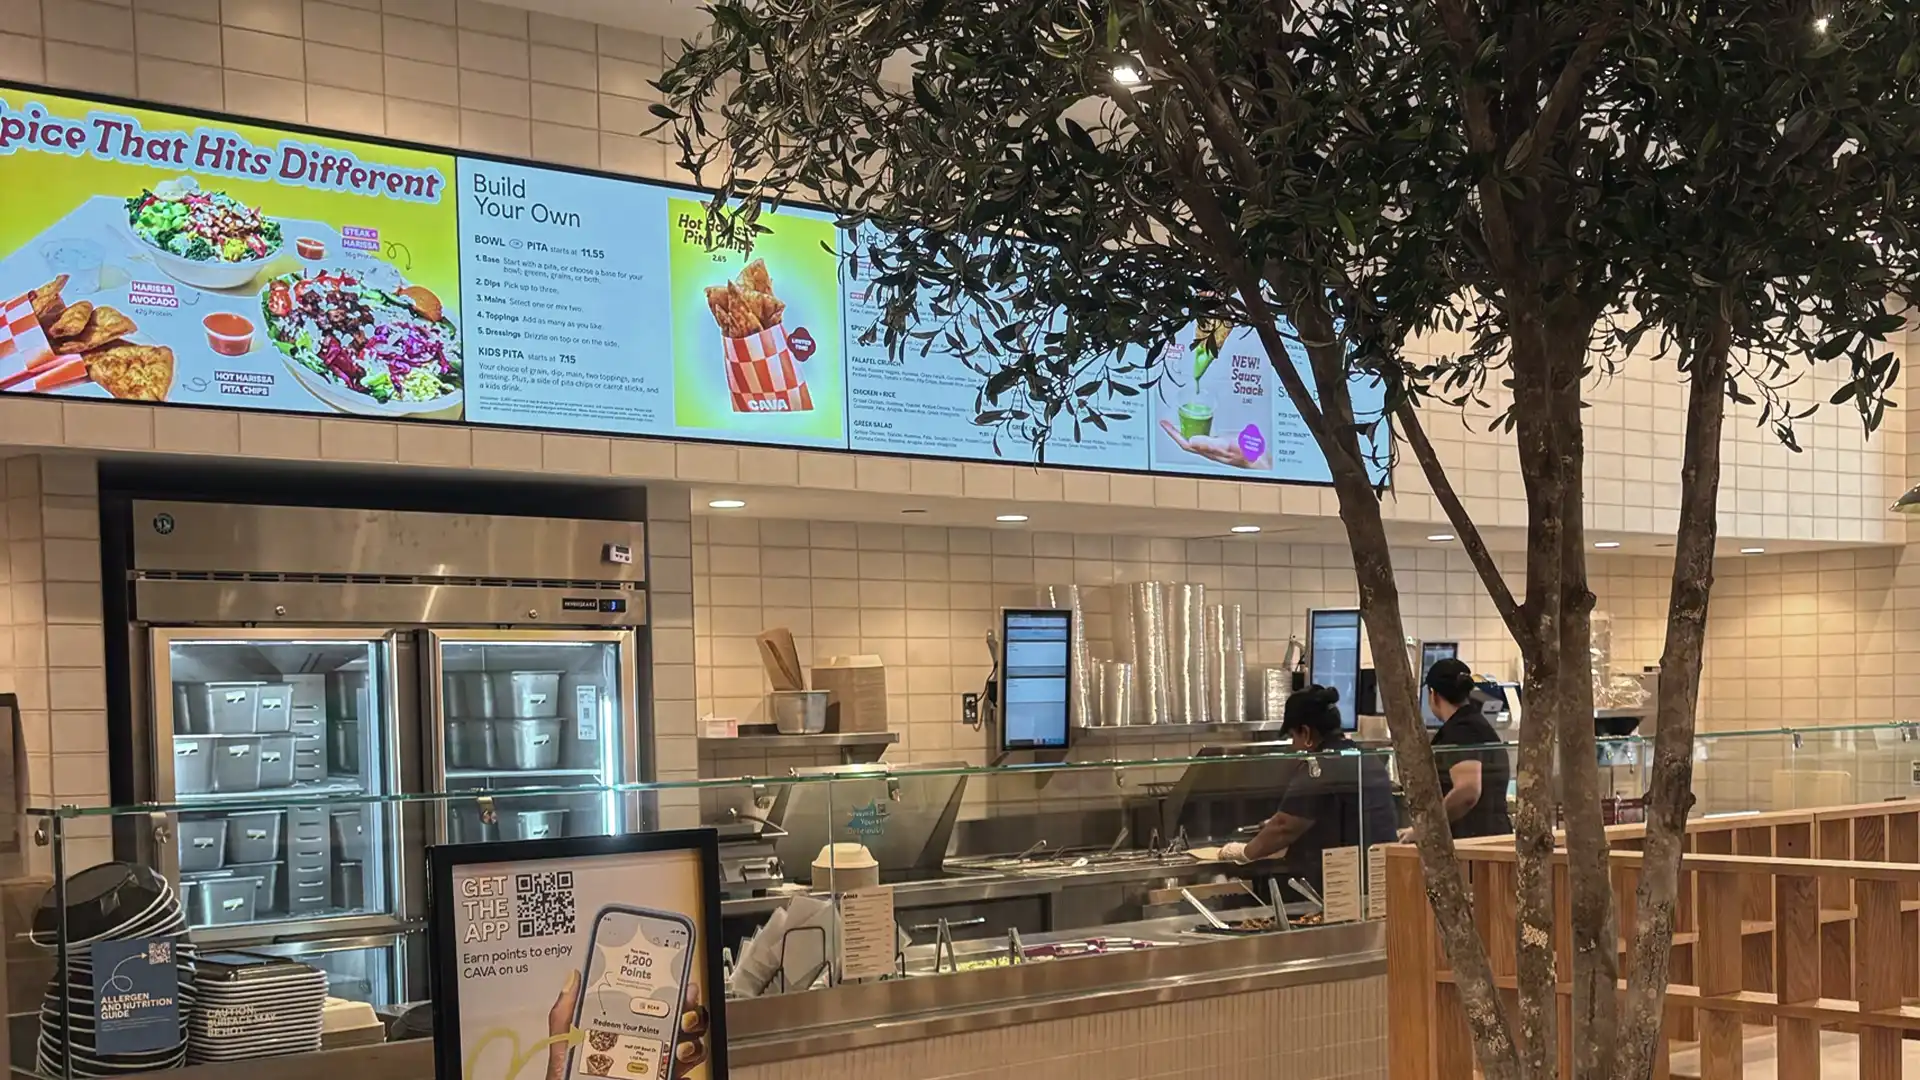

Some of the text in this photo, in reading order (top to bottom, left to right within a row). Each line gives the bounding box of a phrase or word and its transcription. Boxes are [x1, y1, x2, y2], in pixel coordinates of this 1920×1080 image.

[0, 105, 439, 197] pice That Hits Different
[474, 173, 525, 198] Build
[474, 195, 580, 227] Your Own
[678, 214, 703, 230] Hot
[683, 230, 711, 245] Pit
[474, 234, 506, 247] BOWL
[527, 241, 548, 252] PITA
[550, 246, 570, 255] starts
[581, 248, 605, 259] 11.55
[475, 254, 481, 262] 1.
[482, 255, 500, 264] Base
[504, 257, 521, 266] Start
[522, 260, 536, 268] with
[133, 283, 173, 293] HARISSA
[475, 278, 482, 286] 2.
[483, 279, 500, 288] Dips
[504, 281, 519, 289] Pick
[520, 283, 530, 291] up
[530, 284, 538, 292] to
[131, 295, 177, 306] AVOCADO
[476, 294, 483, 302] 3.
[484, 295, 506, 305] Mains
[477, 311, 484, 319] 4.
[485, 311, 519, 323] Toppings
[522, 315, 537, 324] Add
[477, 327, 485, 335] 5.
[485, 327, 521, 339] Dressings
[478, 347, 501, 357] KIDS
[502, 349, 524, 360] PITA
[528, 352, 548, 361] starts
[559, 354, 576, 364] 7.15
[852, 357, 881, 367] FALAFEL
[1232, 355, 1260, 369] NEW!
[216, 372, 273, 383] HOT HARISSA
[480, 362, 495, 371] Your
[497, 364, 519, 374] choice
[631, 376, 644, 384] and
[1231, 368, 1261, 384] Saucy
[242, 386, 267, 395] CHIPS
[485, 382, 500, 390] kids
[536, 377, 551, 385] side
[575, 380, 593, 390] chips
[1233, 382, 1263, 396] Snack
[853, 388, 879, 397] CHICKEN
[747, 399, 788, 410] CAVA
[461, 875, 508, 898] GET
[462, 898, 510, 921] THE
[464, 921, 510, 944] APP
[463, 944, 573, 965] Earn points to enjoy
[624, 954, 653, 968] 1,200
[464, 964, 528, 979] CAVA on us
[620, 966, 652, 980] Points
[100, 992, 150, 1004] ALLERGEN
[101, 998, 172, 1012] AND NUTRITION
[101, 1010, 130, 1020] GUIDE
[593, 1018, 660, 1035] Redeem Your Points
